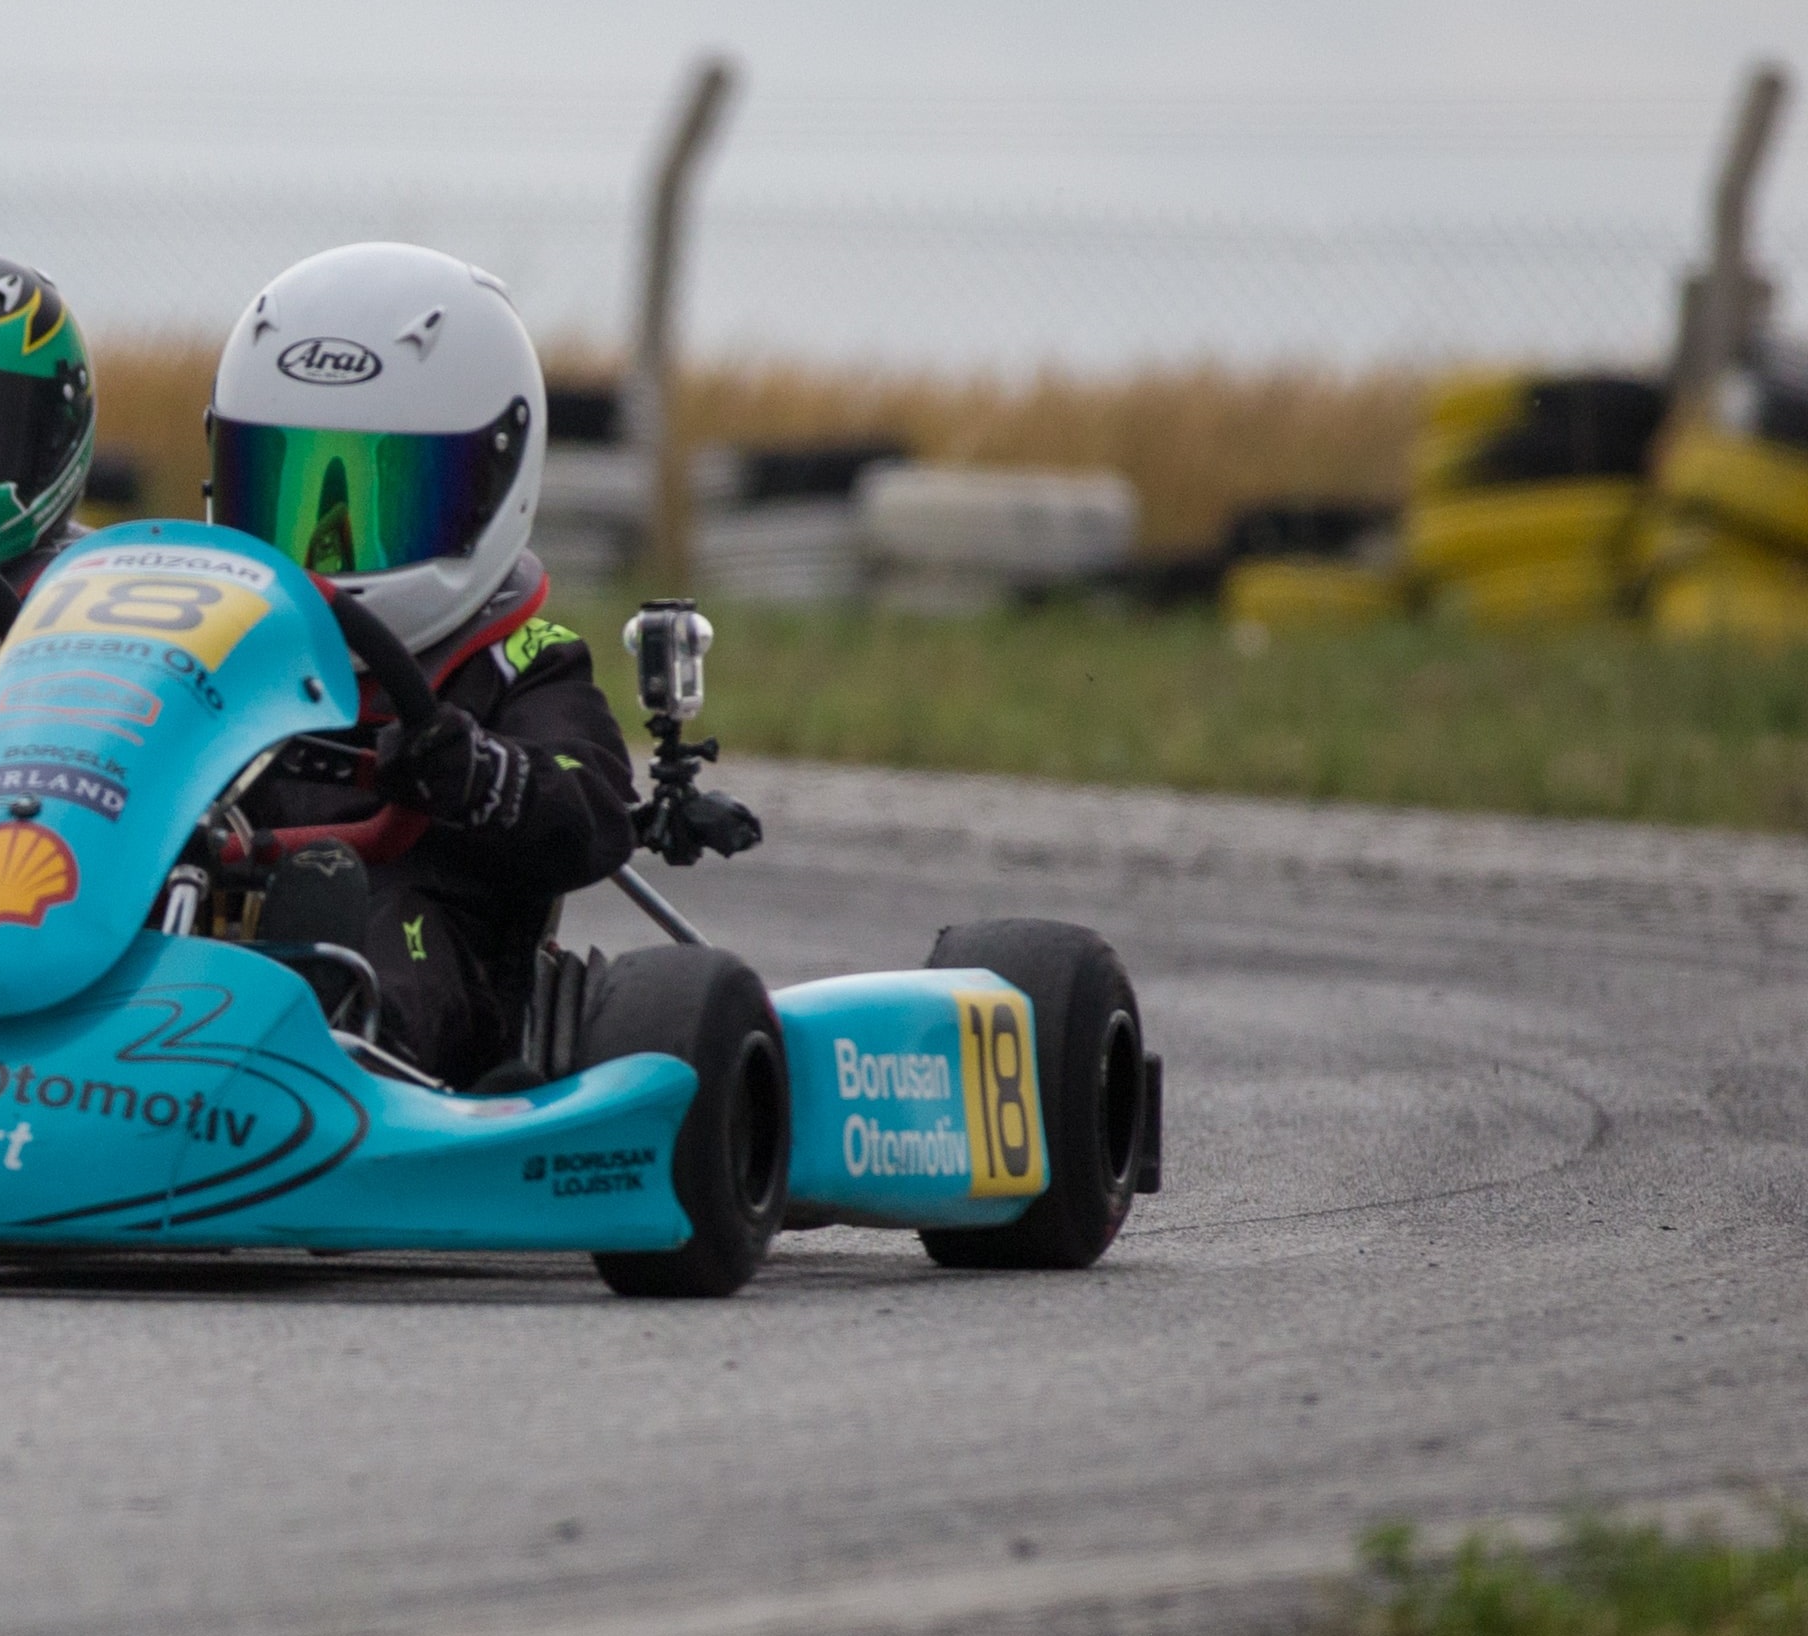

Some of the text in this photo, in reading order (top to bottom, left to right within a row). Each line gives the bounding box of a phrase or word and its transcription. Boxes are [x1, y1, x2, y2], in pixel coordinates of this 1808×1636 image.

[282, 340, 369, 373] Arai
[112, 552, 262, 585] RÜZGAR
[32, 577, 223, 632] 18
[8, 638, 154, 663] orusan
[163, 648, 224, 711] Oto
[833, 1037, 951, 1101] Borusan
[969, 1002, 1030, 1179] 18
[553, 1148, 657, 1173] BORUSAN
[844, 1112, 969, 1178] Otomotiv
